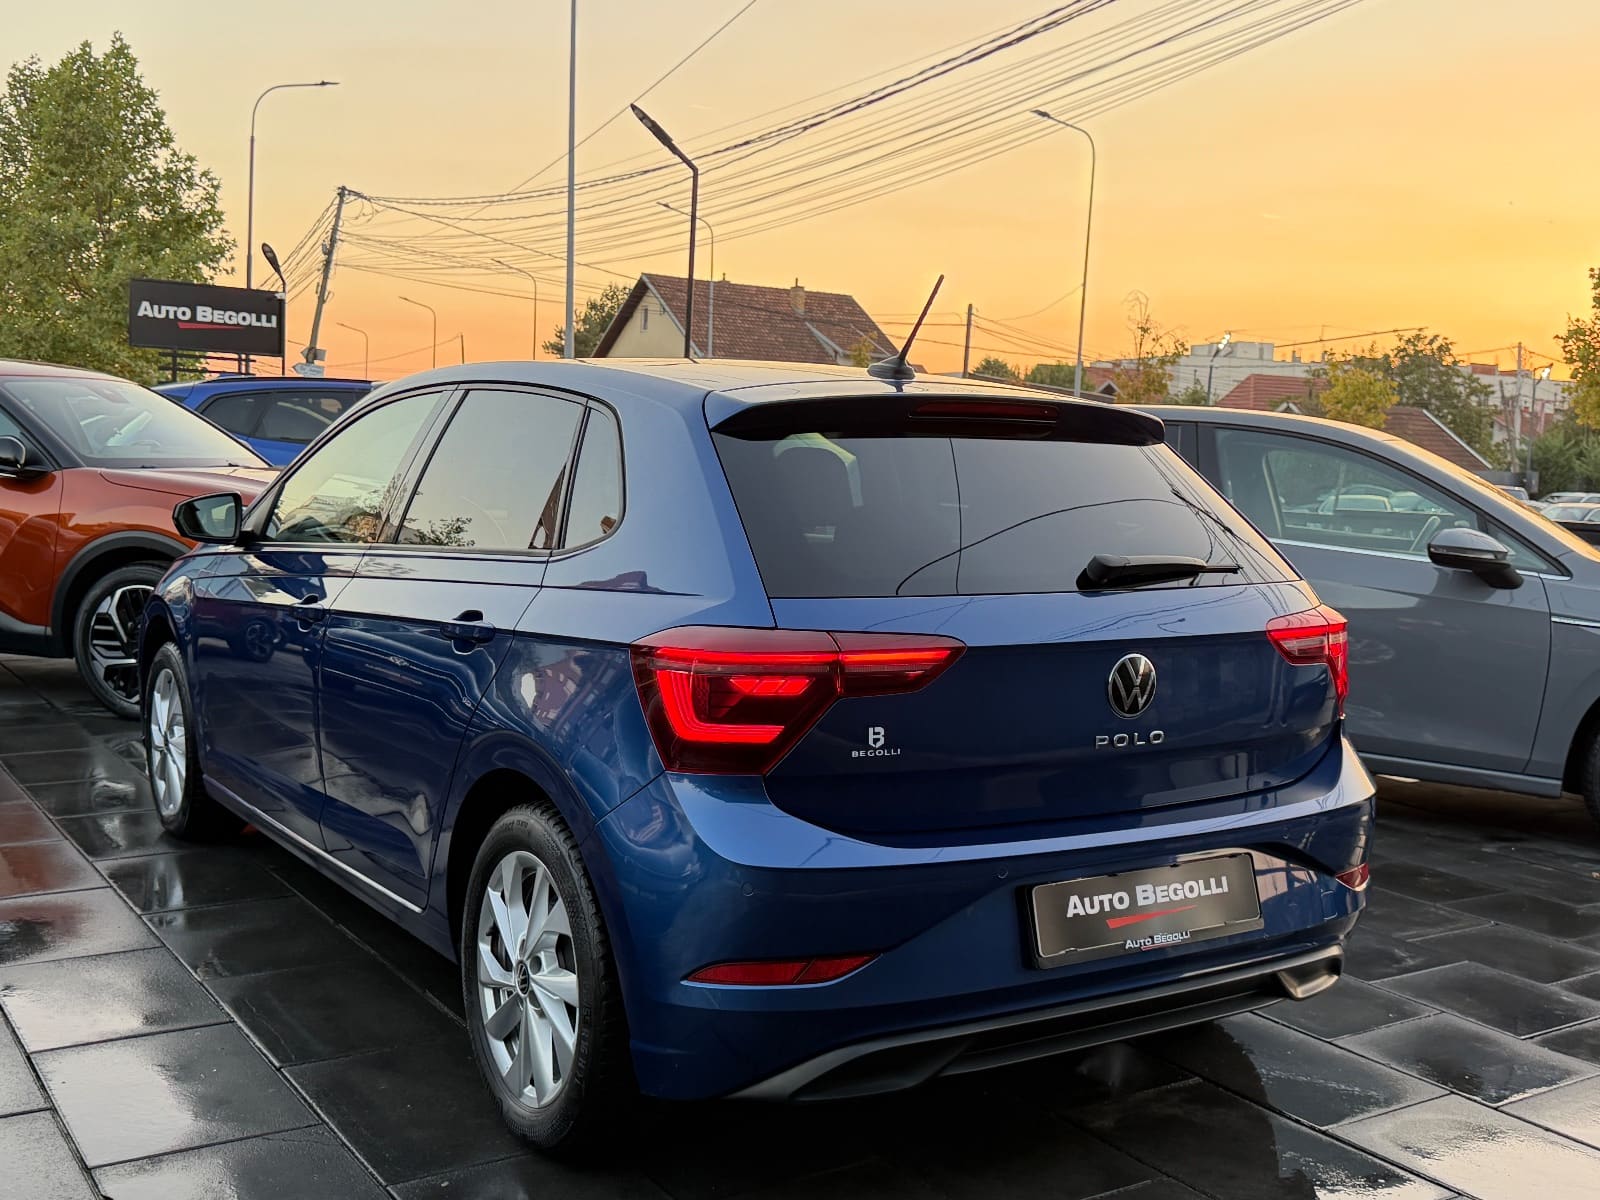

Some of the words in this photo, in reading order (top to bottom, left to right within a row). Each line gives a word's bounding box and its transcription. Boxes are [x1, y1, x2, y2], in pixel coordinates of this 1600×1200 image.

[137, 300, 192, 321] AUTO
[196, 305, 277, 328] BEGOLLI
[1095, 730, 1165, 750] POLO
[851, 748, 901, 758] BEGOLLI
[1066, 891, 1130, 918] AUTO
[1135, 876, 1229, 907] BEGOLLI
